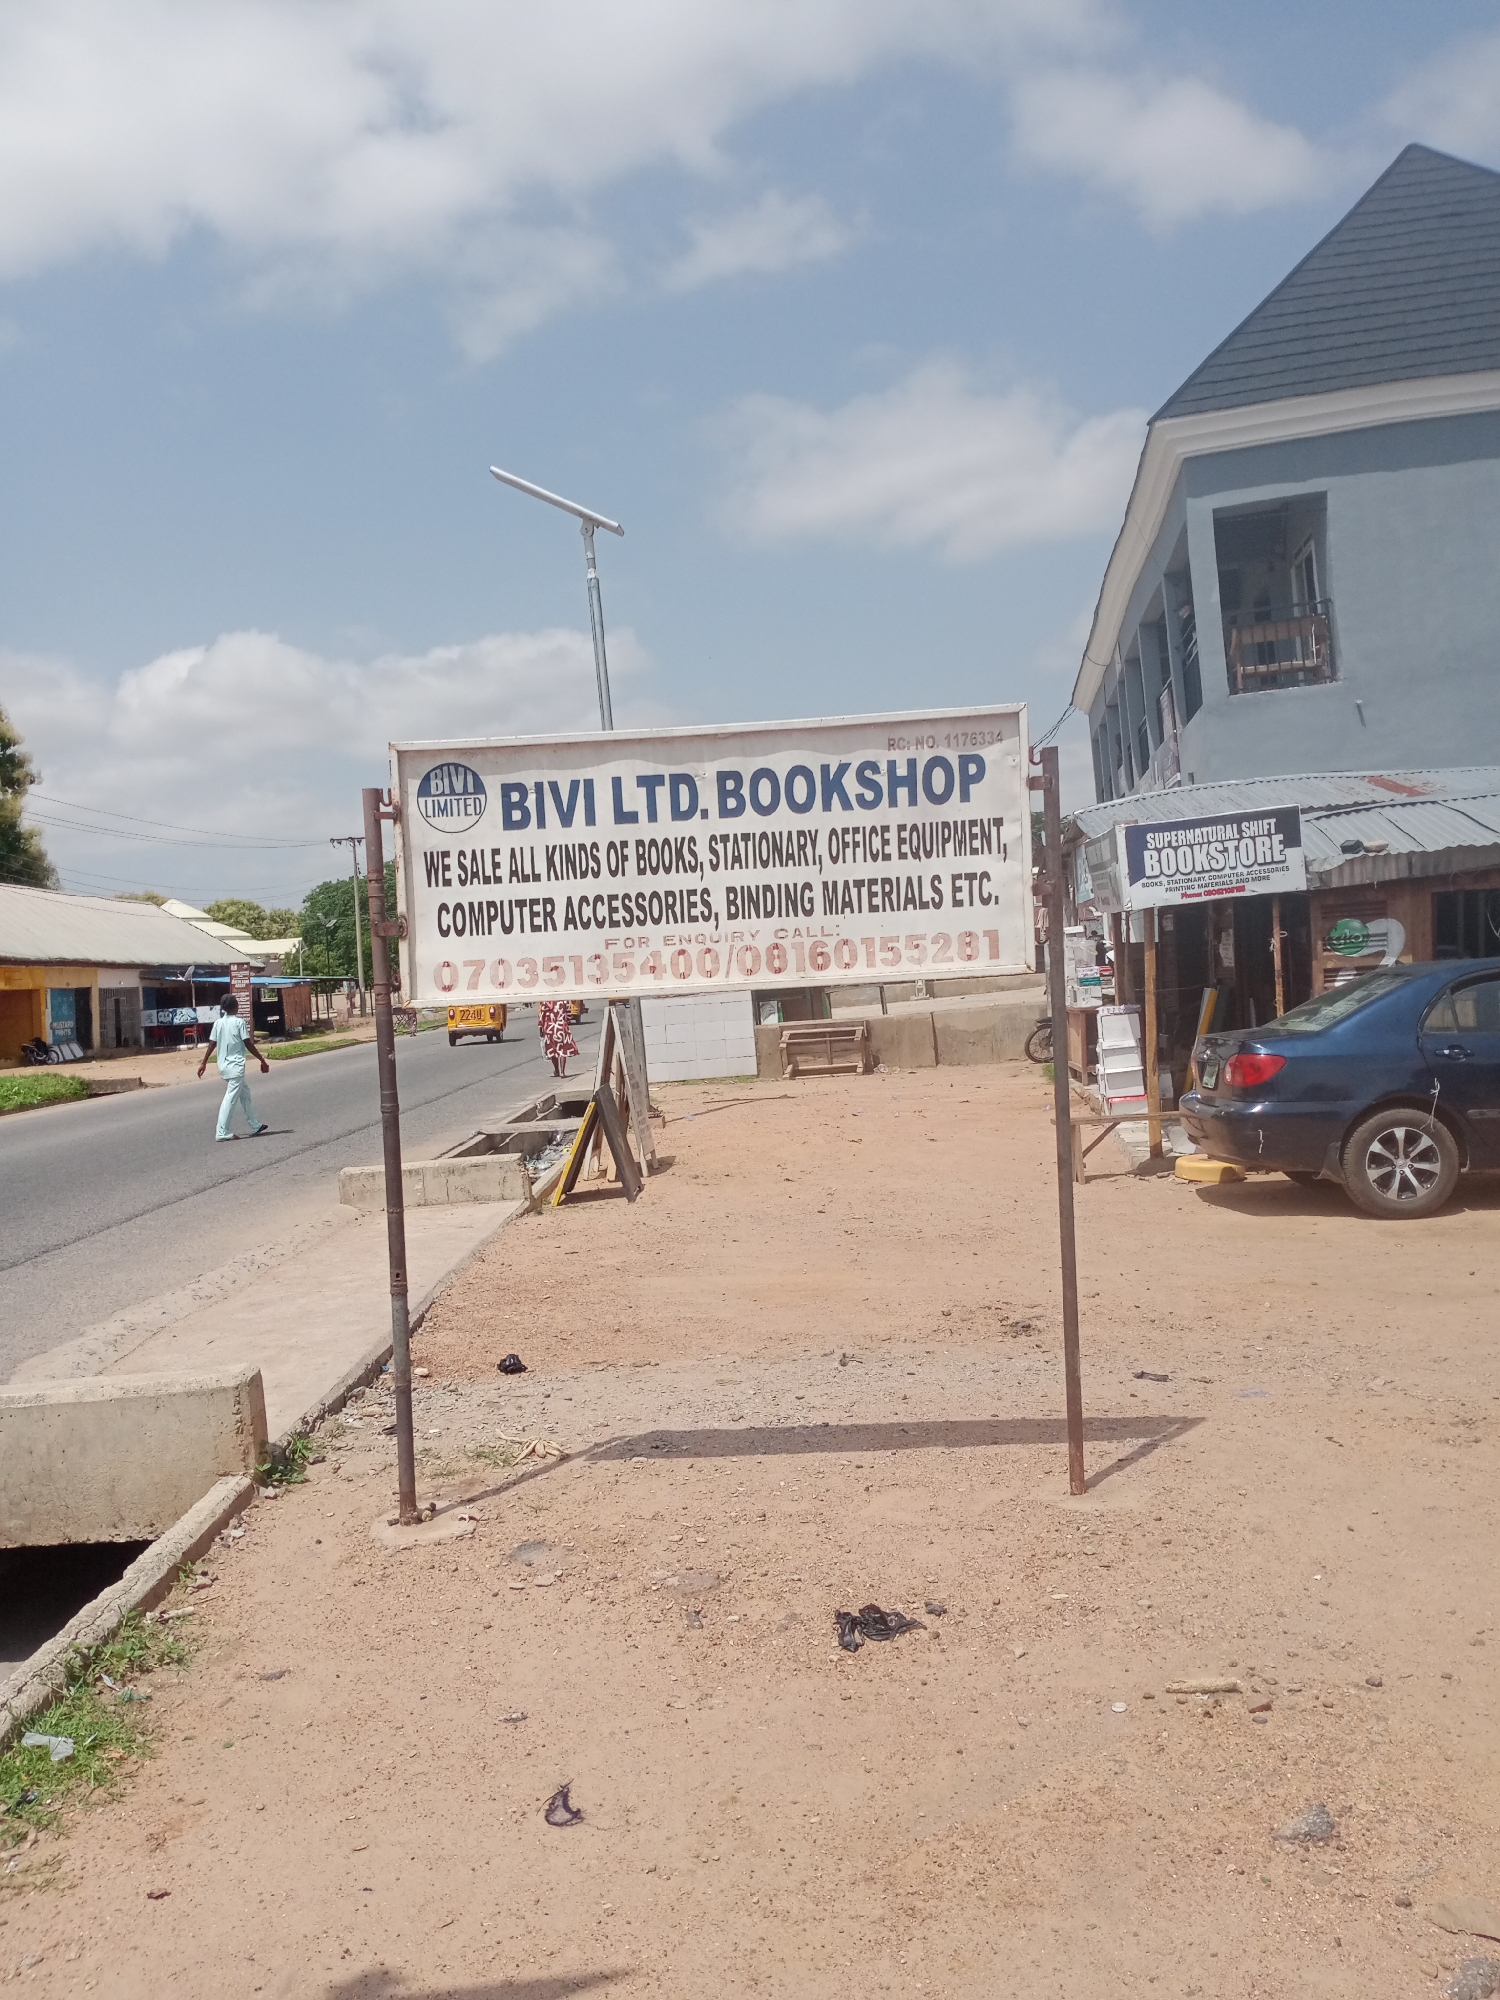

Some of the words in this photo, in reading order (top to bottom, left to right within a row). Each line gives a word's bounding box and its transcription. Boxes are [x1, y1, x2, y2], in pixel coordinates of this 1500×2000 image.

[915, 734, 940, 751] NO.
[944, 729, 1004, 748] 1176334
[429, 765, 475, 796] BIVI
[500, 778, 597, 832] BIVI
[716, 753, 986, 819] BOOKSHOP
[424, 796, 482, 818] LIMITED
[1146, 823, 1240, 850] SUPERNATURAL
[1241, 818, 1277, 838] SHIFT
[423, 850, 453, 888] WE
[457, 847, 503, 887] SALE
[508, 845, 542, 884] ALL
[545, 841, 602, 882] KINDS
[606, 839, 629, 878] OF
[635, 835, 705, 882] BOOKS,
[708, 828, 824, 875] STATIONARY,
[828, 824, 891, 864] OFFICE
[897, 816, 1008, 864] EQUIPMENT,
[1143, 833, 1287, 879] BOOKSTORE
[1165, 884, 1196, 893] PRINTING
[1197, 879, 1234, 890] MATERIALS
[1235, 877, 1250, 885] AND
[1251, 874, 1271, 882] MORE
[1208, 871, 1245, 881] COMPUTER
[1246, 865, 1290, 877] ACCESSORIES
[437, 896, 558, 938] COMPUTER
[563, 887, 720, 932] ACCESSORIES,
[726, 881, 815, 921] BINDING
[821, 874, 944, 916] MATERIALS
[951, 870, 999, 909] ETC.
[604, 936, 651, 950] FOR
[662, 929, 761, 947] ENQUIRY
[774, 924, 841, 940] CALL:
